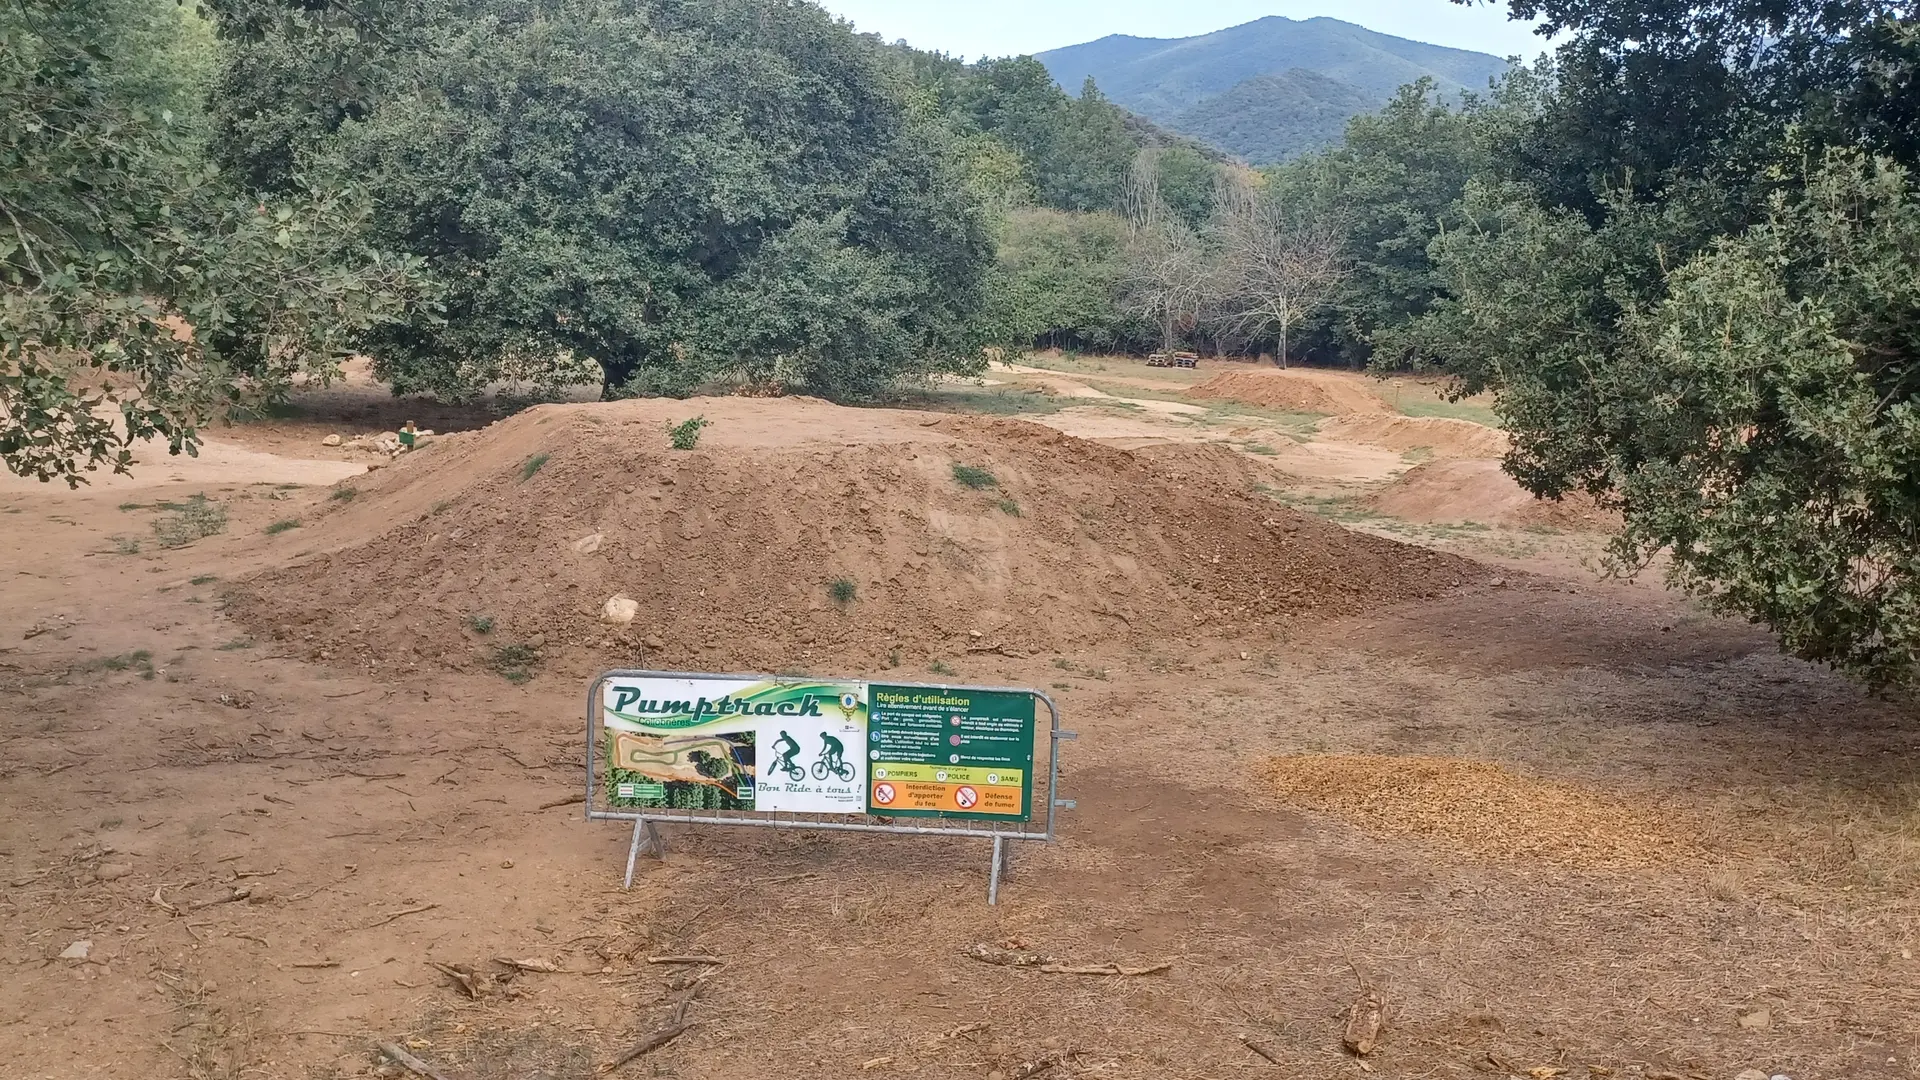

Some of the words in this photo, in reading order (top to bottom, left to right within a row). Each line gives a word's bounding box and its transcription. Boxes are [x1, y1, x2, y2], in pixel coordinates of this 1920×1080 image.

[612, 686, 823, 721] Pumptrack
[876, 693, 910, 704] Règles
[912, 694, 970, 706] d'utilisation
[758, 782, 780, 792] Bon
[785, 783, 812, 792] Ride
[908, 792, 943, 800] d'apporter
[984, 792, 1013, 800] Défense
